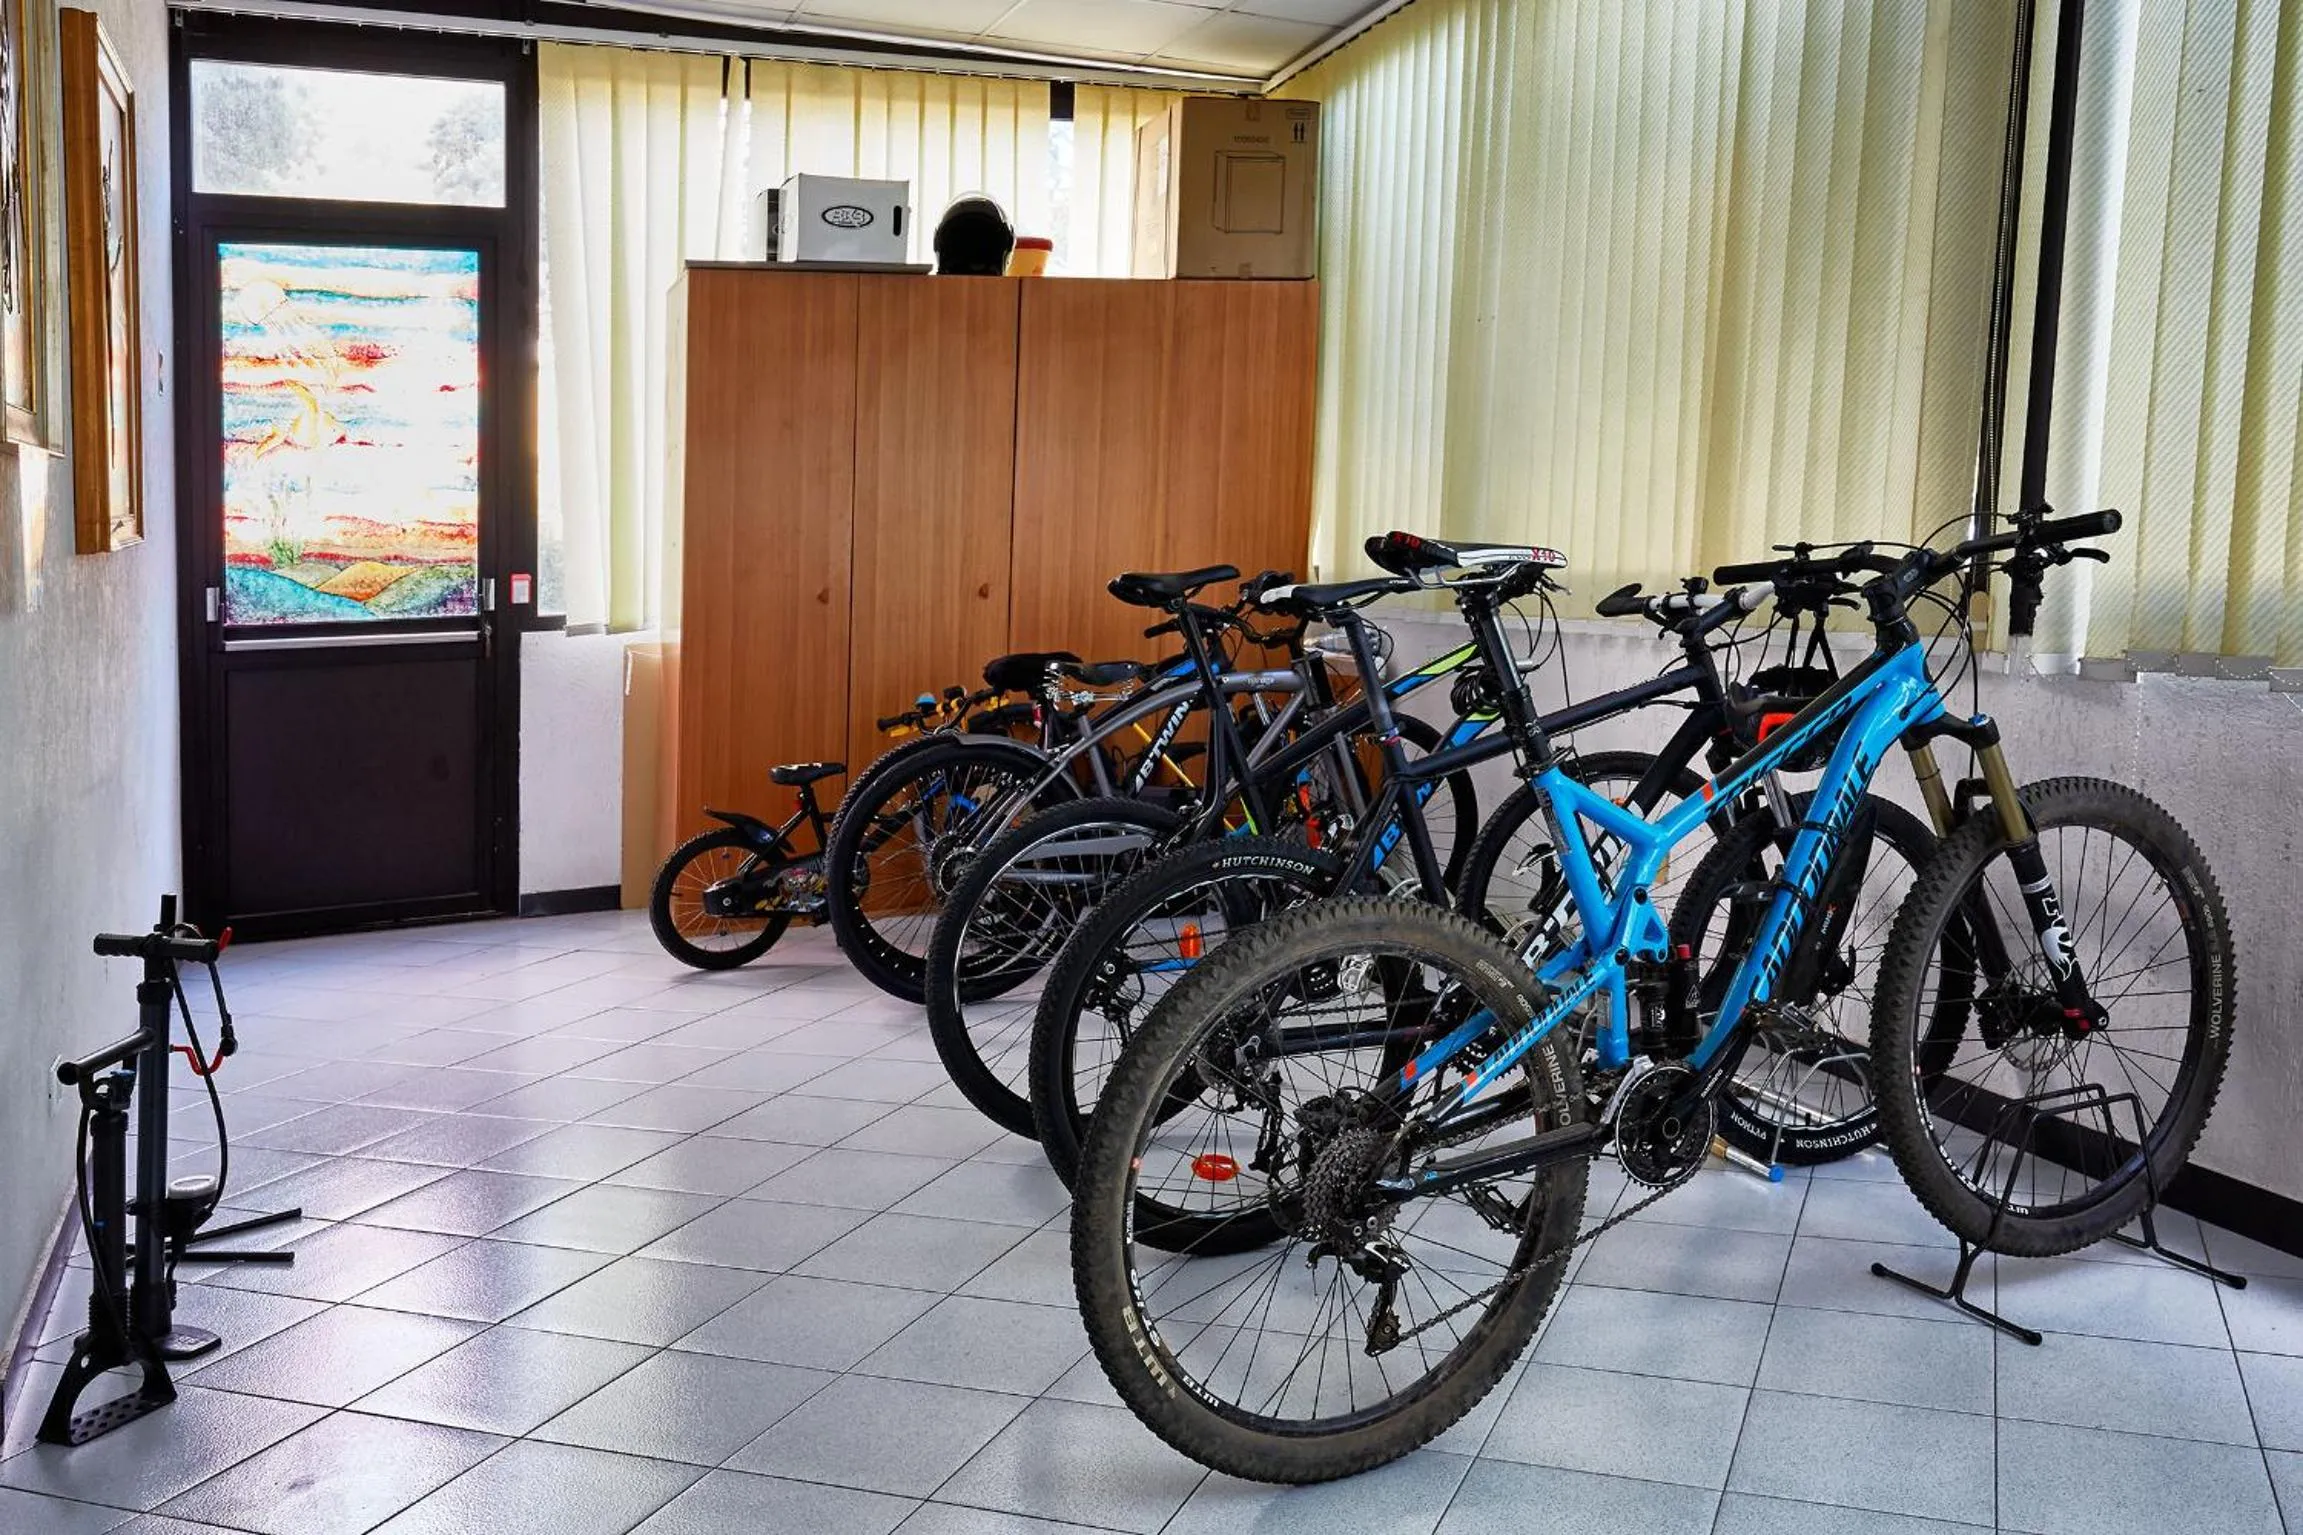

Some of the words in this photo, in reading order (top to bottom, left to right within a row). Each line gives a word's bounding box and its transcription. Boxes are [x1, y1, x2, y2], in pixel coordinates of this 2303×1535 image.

[1221, 856, 1315, 875] HUTCHINSON
[2209, 953, 2223, 1039] WOLVERINE
[1542, 1043, 1572, 1127] OLVERINE
[1731, 1111, 1767, 1140] PYTHON
[1796, 1126, 1871, 1149] HUTCHINSON
[1122, 1305, 1168, 1387] WTB
[1182, 1375, 1220, 1407] WTB
